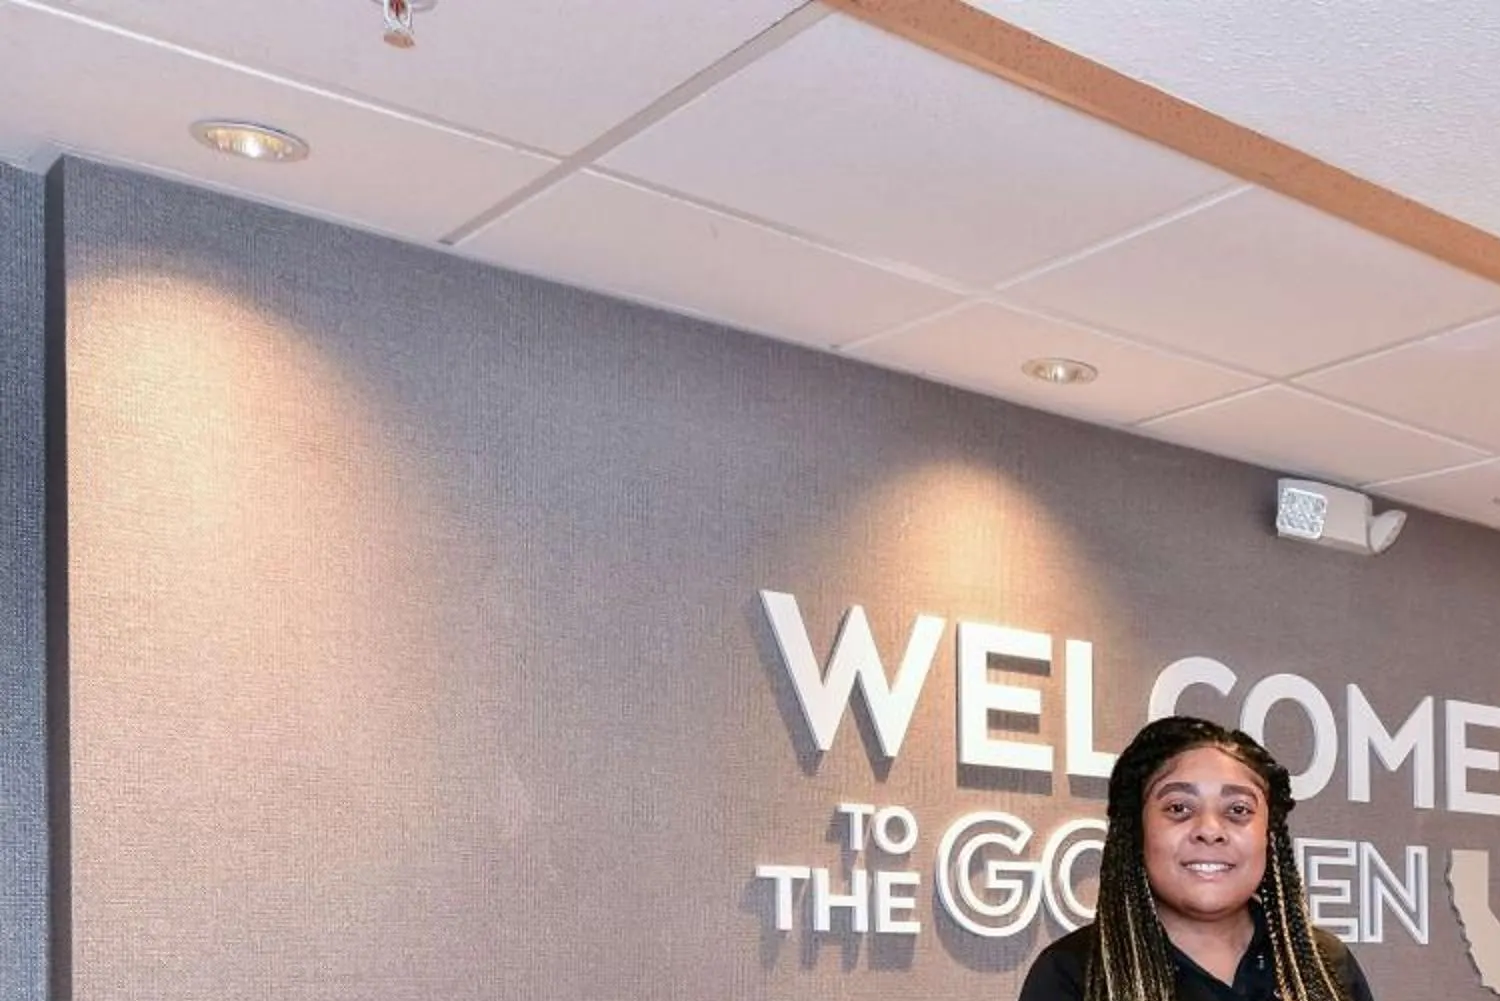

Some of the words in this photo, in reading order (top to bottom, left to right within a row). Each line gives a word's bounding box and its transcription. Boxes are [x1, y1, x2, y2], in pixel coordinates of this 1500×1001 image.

[839, 803, 918, 854] TO
[755, 865, 921, 933] THE
[937, 810, 1429, 945] GOEN
